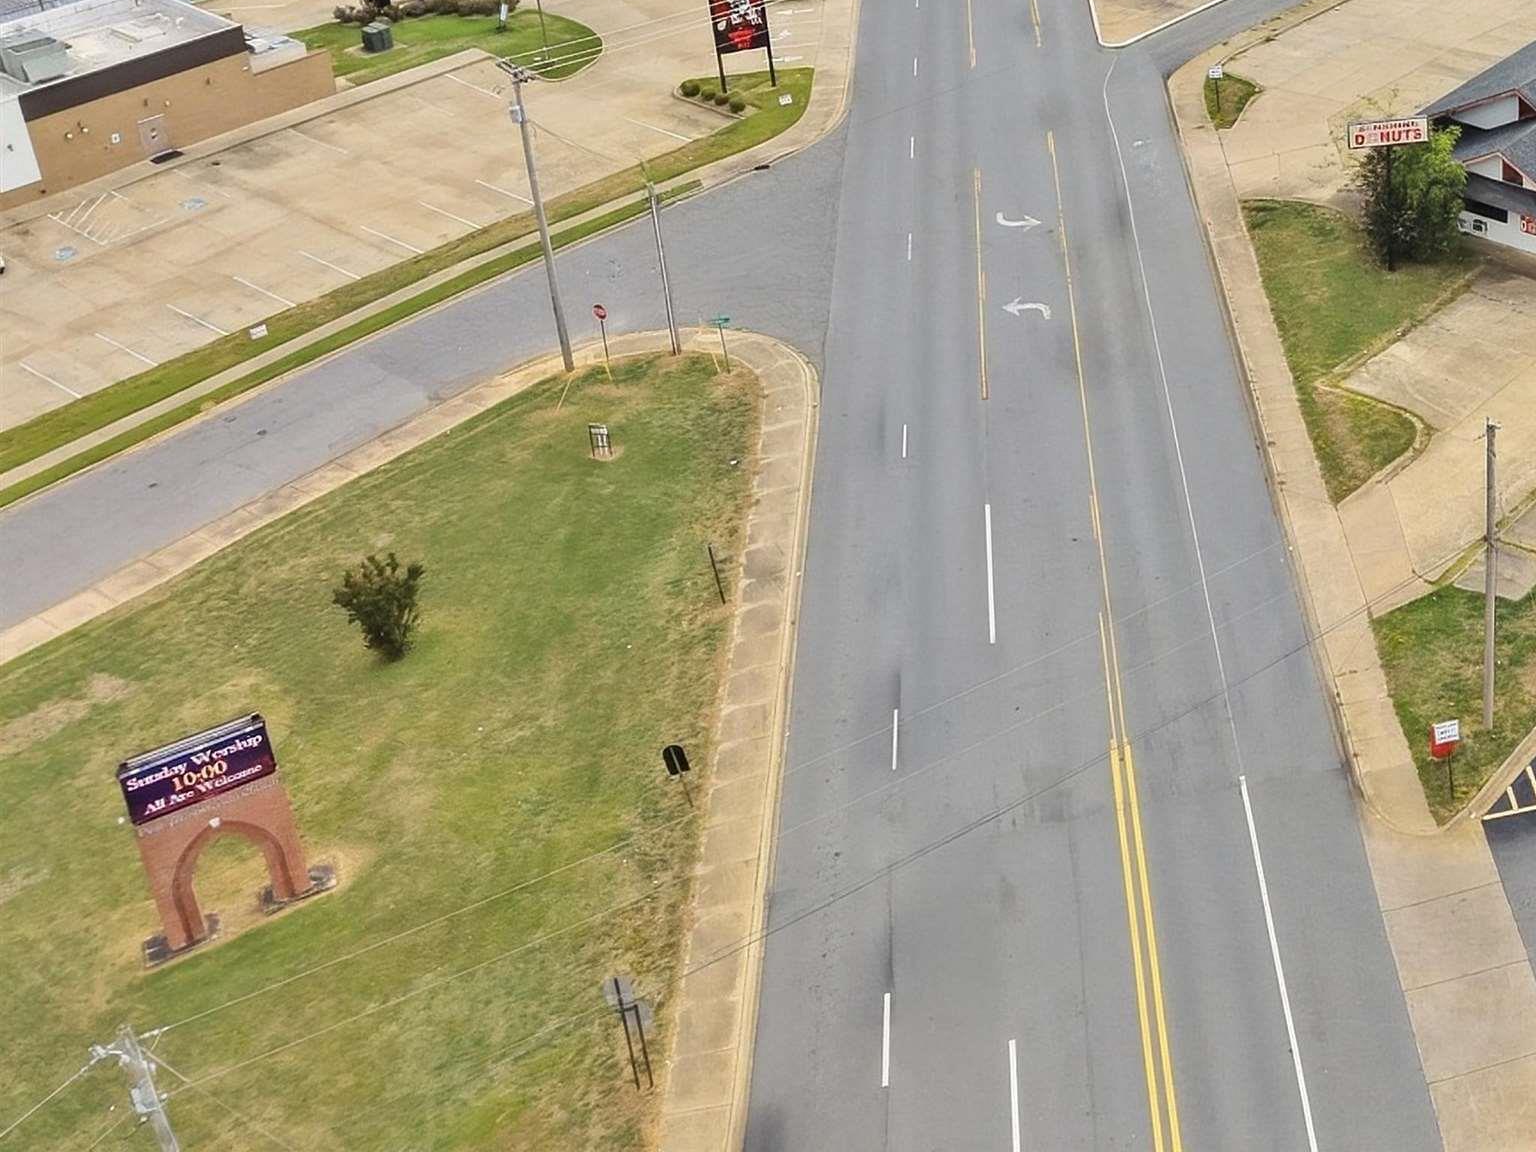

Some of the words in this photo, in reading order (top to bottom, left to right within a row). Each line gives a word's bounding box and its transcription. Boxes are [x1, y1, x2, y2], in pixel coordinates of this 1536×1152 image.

[1355, 128, 1422, 145] DNUTS
[126, 762, 188, 792] Sunday
[190, 734, 263, 766] Worship
[171, 760, 228, 792] 10:00
[144, 800, 166, 815] All
[168, 789, 195, 806] Are
[195, 764, 263, 793] Welcome
